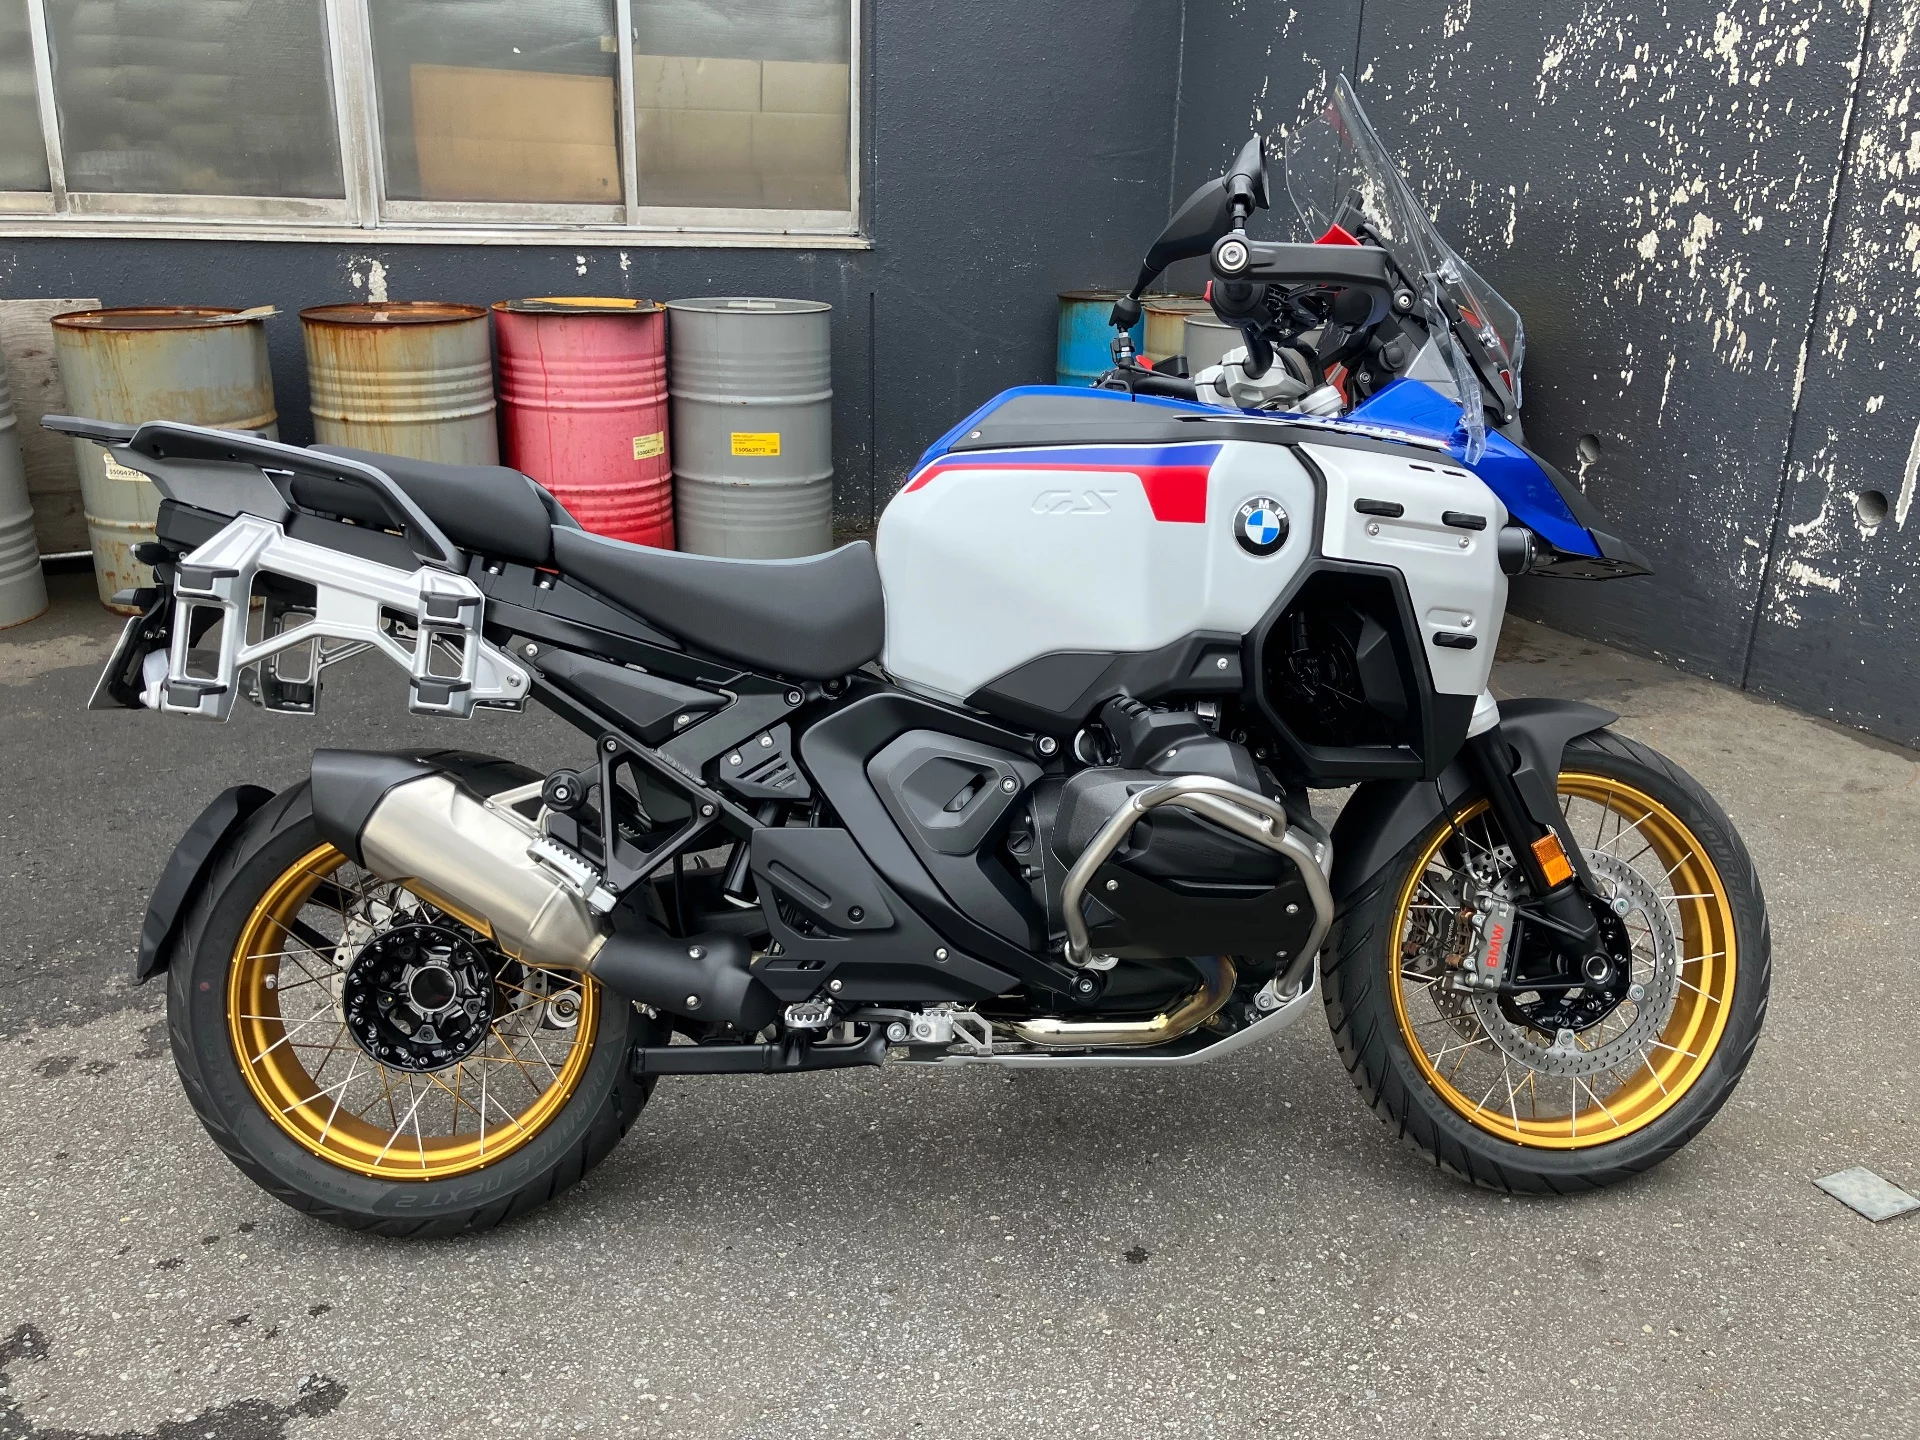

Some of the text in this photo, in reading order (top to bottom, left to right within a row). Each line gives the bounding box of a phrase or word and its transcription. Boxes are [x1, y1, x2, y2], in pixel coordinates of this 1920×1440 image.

[1030, 489, 1118, 515] GS
[1240, 498, 1287, 521] BMW
[1485, 923, 1505, 968] BMW
[515, 1047, 614, 1175] TOURANCE
[394, 1194, 418, 1208] 2
